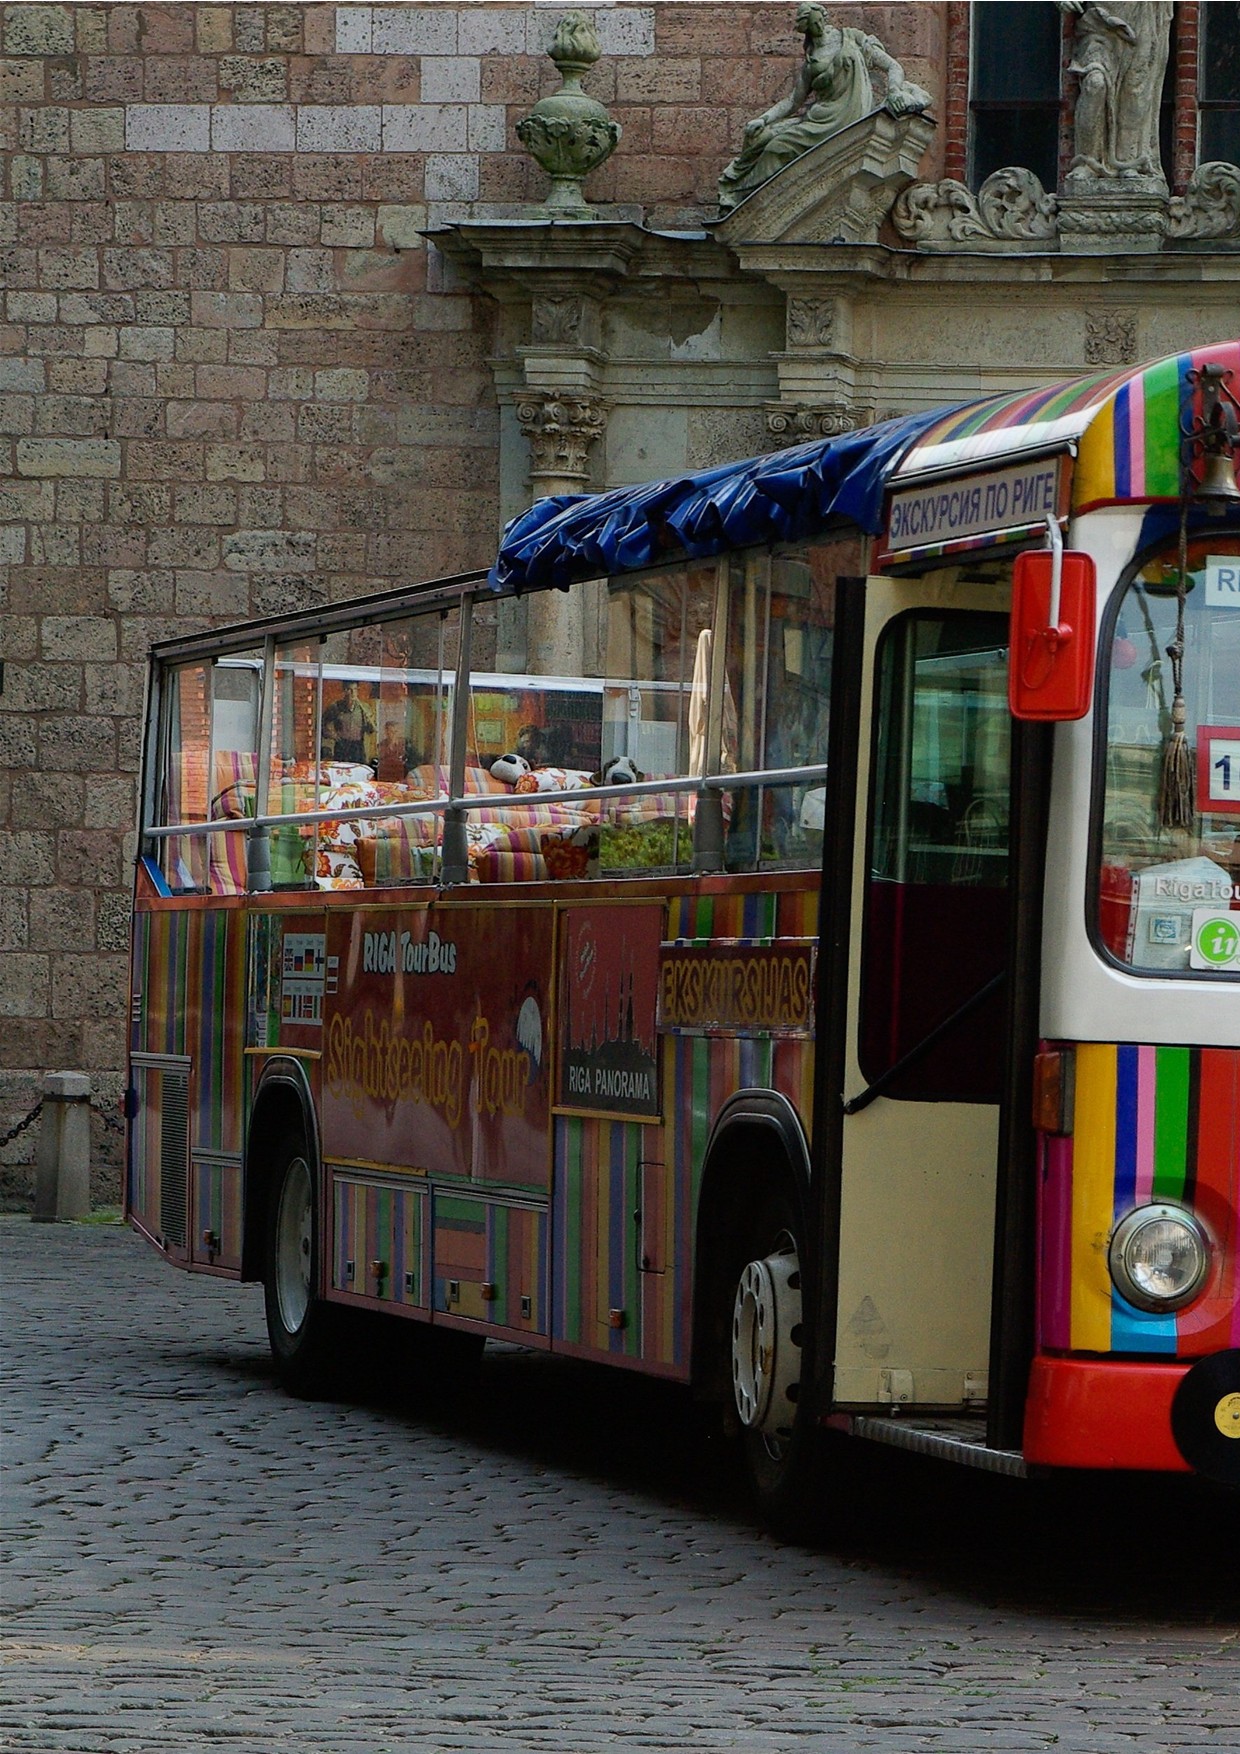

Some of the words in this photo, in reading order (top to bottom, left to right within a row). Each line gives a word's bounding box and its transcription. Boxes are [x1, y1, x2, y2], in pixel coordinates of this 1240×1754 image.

[891, 488, 981, 538] ЭКСКУРСИЯ
[984, 481, 1009, 523] ПО
[1013, 472, 1054, 514] РИГЕ
[364, 930, 397, 974] RIGA
[400, 929, 458, 975] TourBus
[661, 956, 810, 1026] EKSKURSIJAS
[328, 1007, 463, 1130] Sightseeing
[568, 1065, 592, 1094] RIGA
[594, 1068, 651, 1101] PANORAMA
